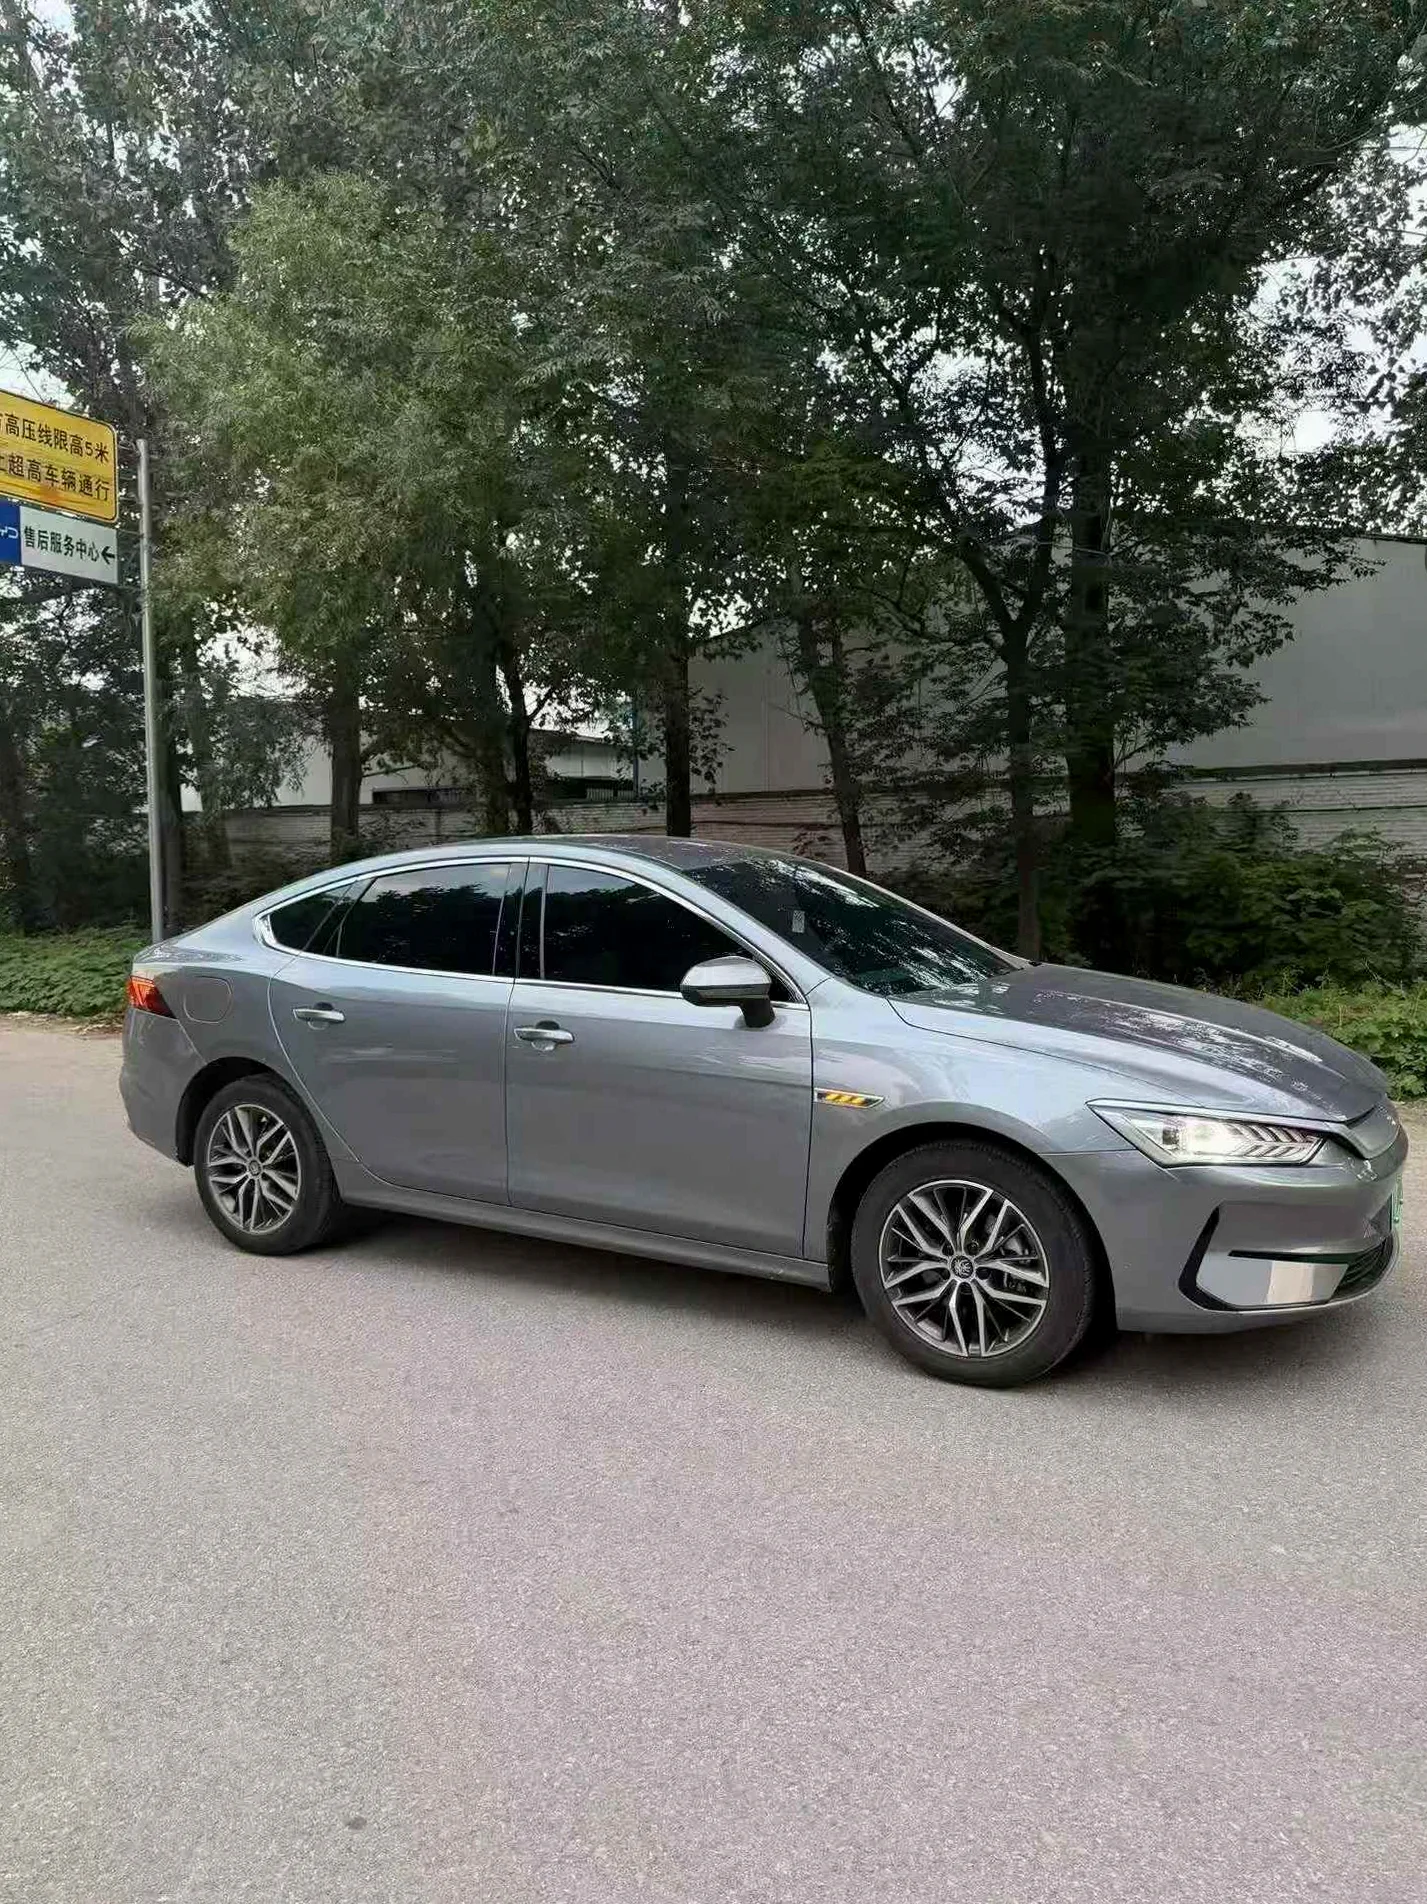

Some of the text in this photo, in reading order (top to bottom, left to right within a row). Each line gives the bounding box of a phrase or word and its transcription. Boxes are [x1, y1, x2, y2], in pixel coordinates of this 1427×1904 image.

[0, 412, 109, 464] 高压线限高5米
[24, 525, 100, 562] 售后服务中心
